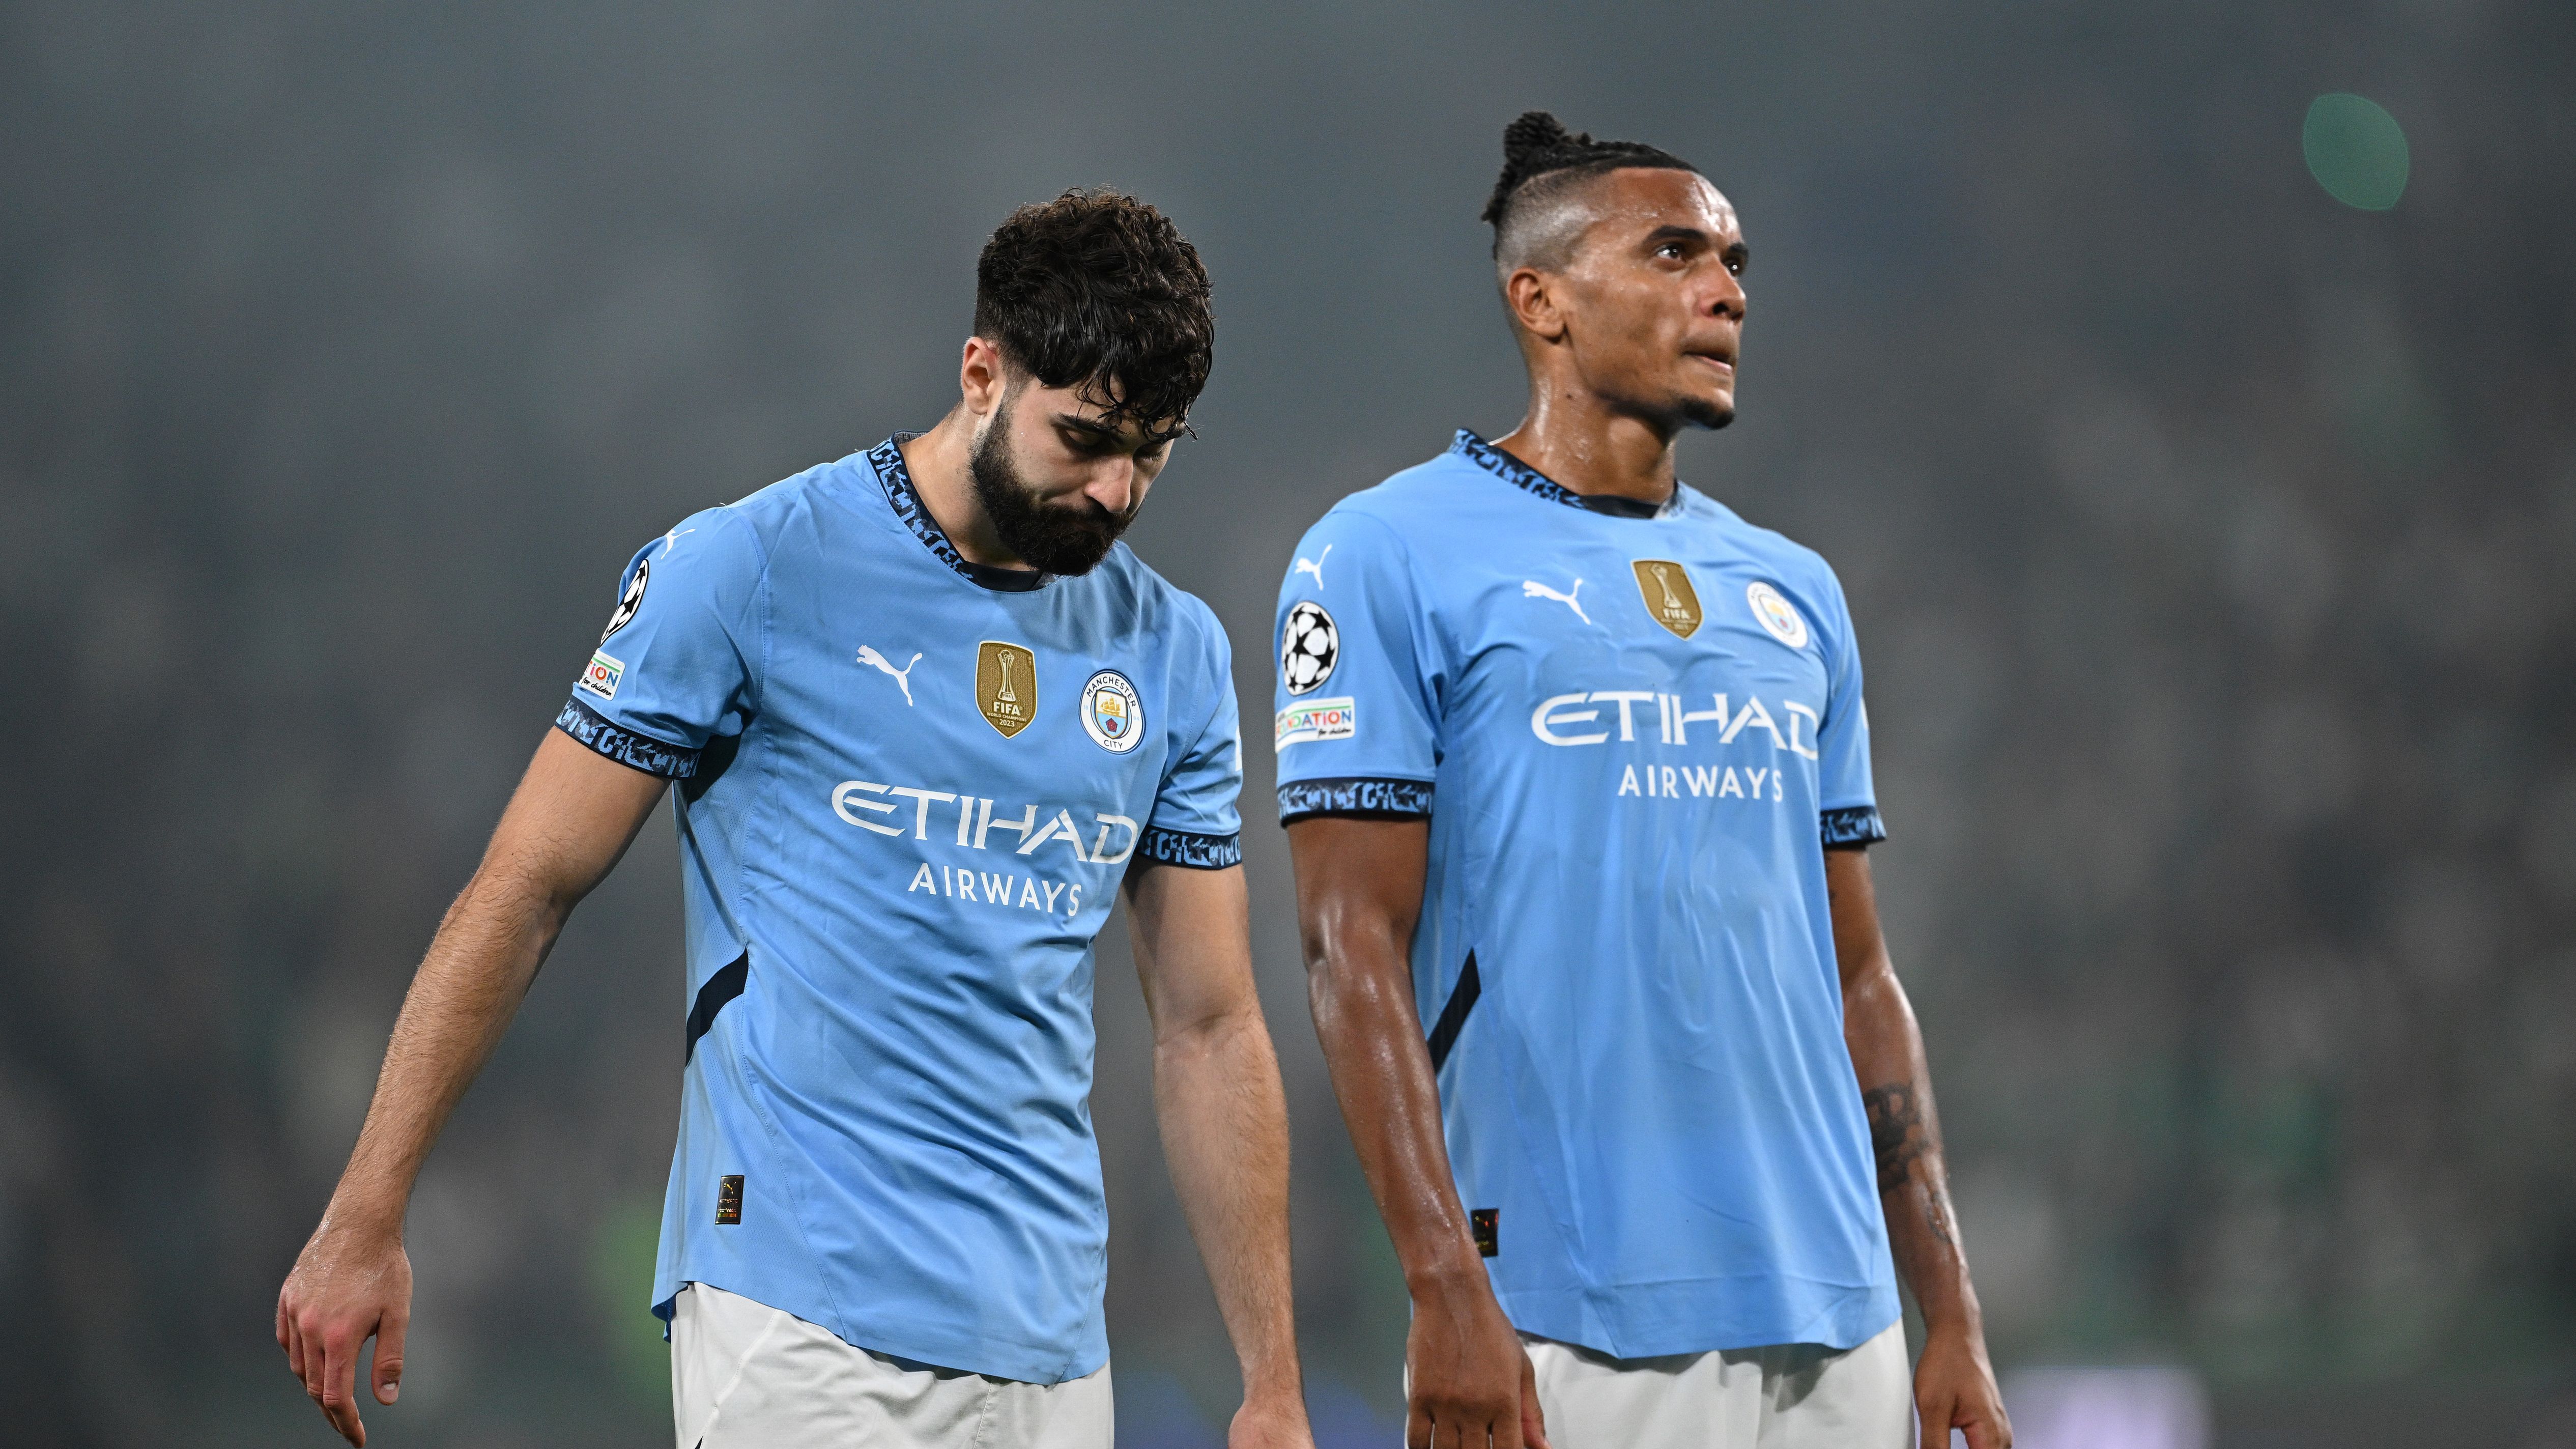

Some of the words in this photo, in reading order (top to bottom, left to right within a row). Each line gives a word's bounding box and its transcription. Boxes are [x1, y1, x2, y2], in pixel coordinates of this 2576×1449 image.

[1663, 608, 1691, 619] FIFA
[581, 676, 590, 685] for
[591, 683, 612, 696] children
[1086, 676, 1136, 707] MANCHESTER
[994, 701, 1021, 716] FIFA
[1003, 714, 1027, 722] CHAMPIONS
[999, 719, 1015, 727] 2023
[1531, 691, 1818, 761] ETIHAD
[1104, 740, 1123, 749] CITY
[1617, 764, 1783, 803] AIRWAYS
[831, 781, 1139, 864] ETIHAD
[908, 862, 1082, 917] AIRWAYS
